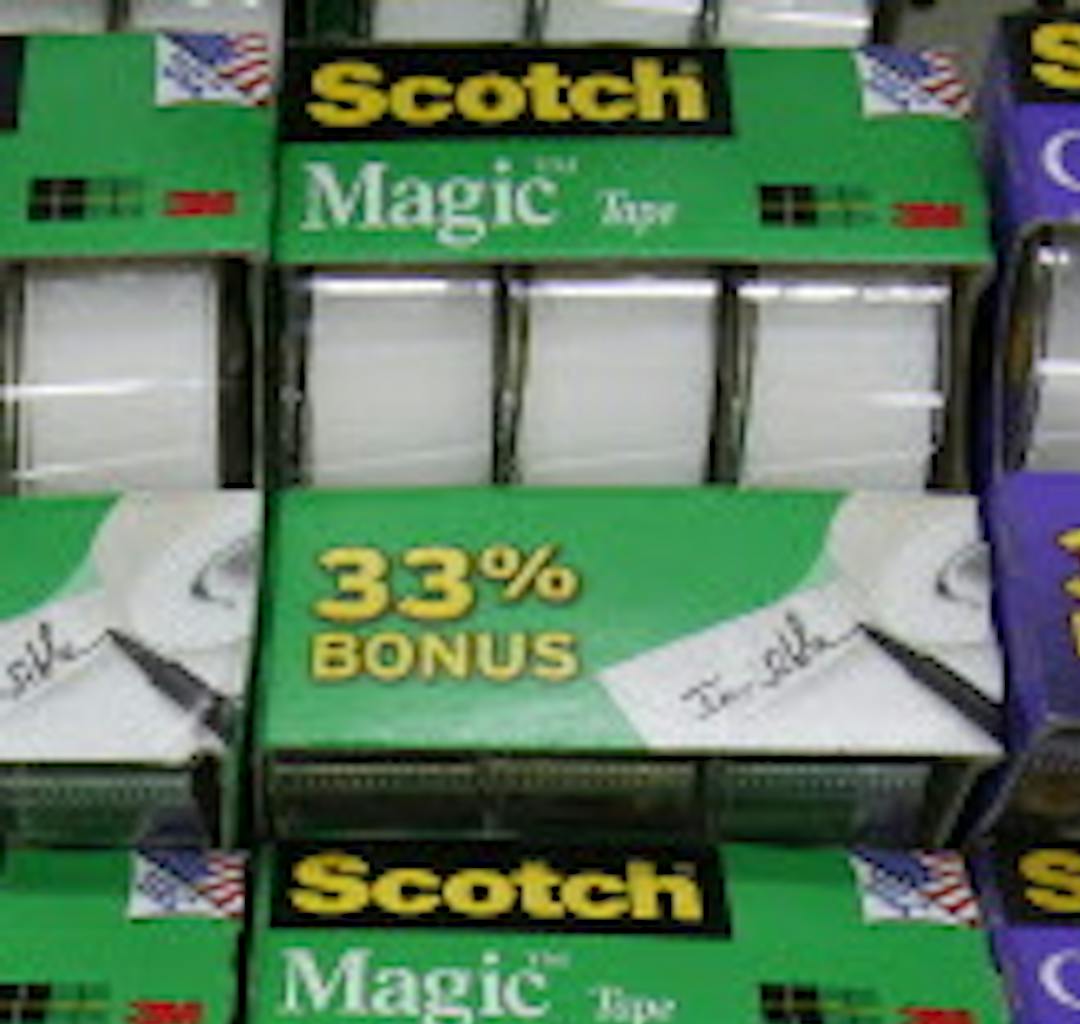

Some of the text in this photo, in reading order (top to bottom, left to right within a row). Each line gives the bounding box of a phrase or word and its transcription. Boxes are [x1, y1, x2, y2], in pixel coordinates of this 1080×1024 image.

[310, 59, 706, 126] Scotch
[313, 547, 578, 621] 33%
[311, 631, 576, 681] BONUS
[292, 855, 702, 920] Scotch
